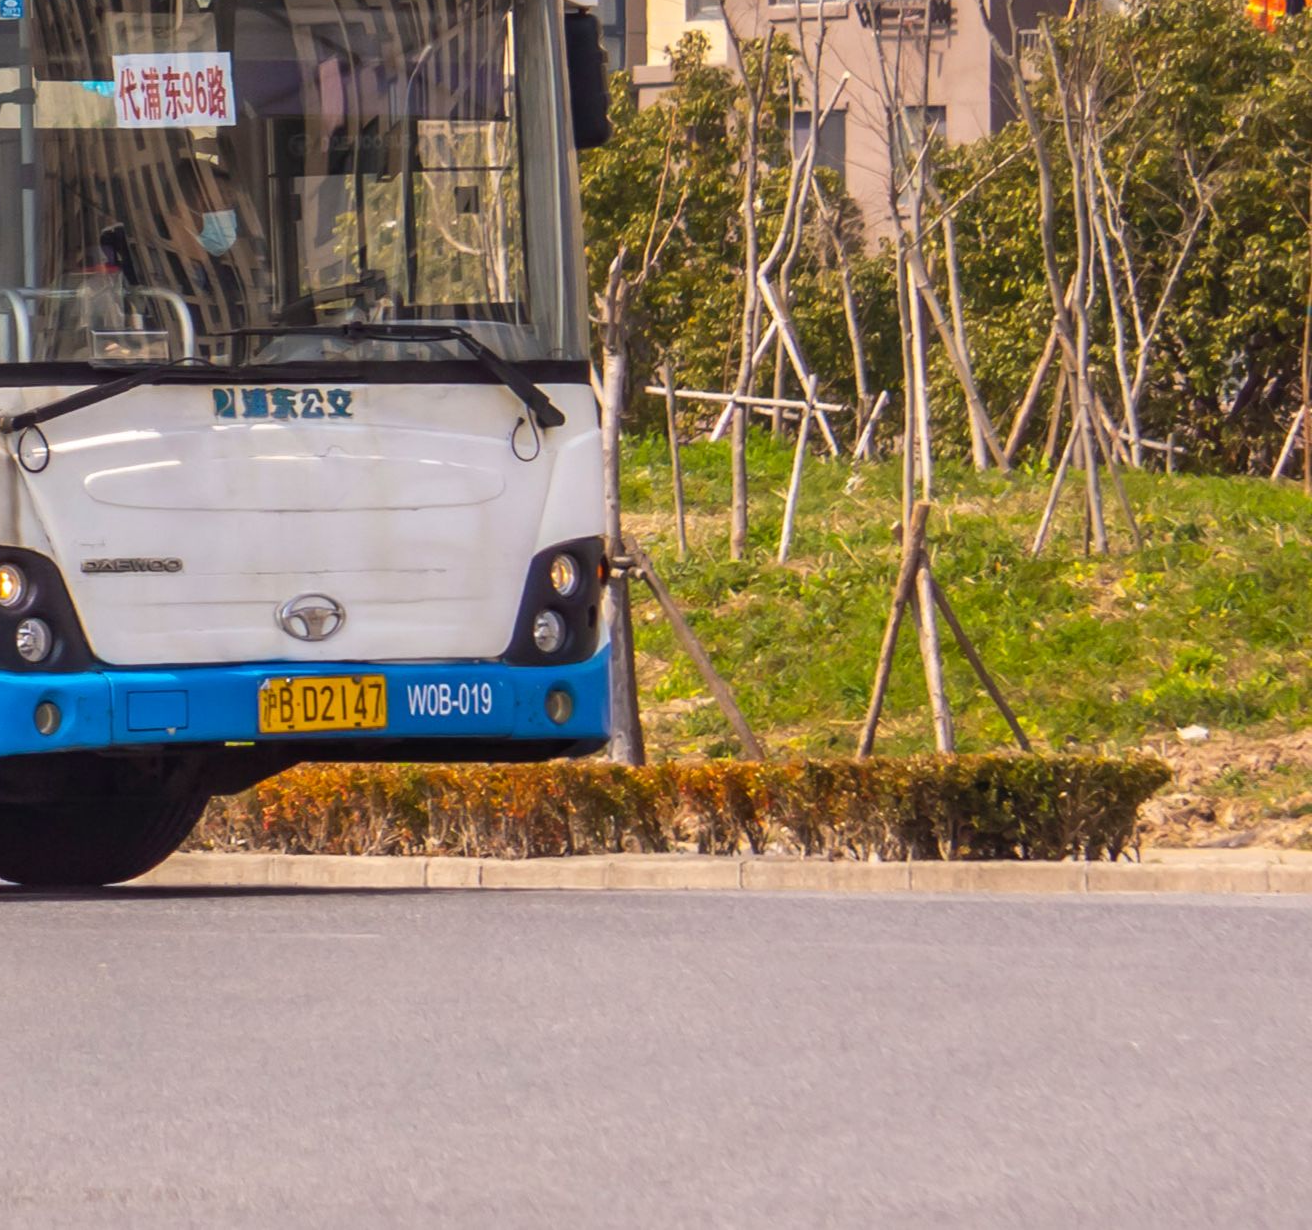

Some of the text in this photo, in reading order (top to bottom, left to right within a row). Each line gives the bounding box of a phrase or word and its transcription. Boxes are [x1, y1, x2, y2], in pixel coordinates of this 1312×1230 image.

[119, 65, 228, 121] 代浦东96路
[241, 387, 353, 419] 浦东公交
[80, 557, 184, 573] DAEWOO
